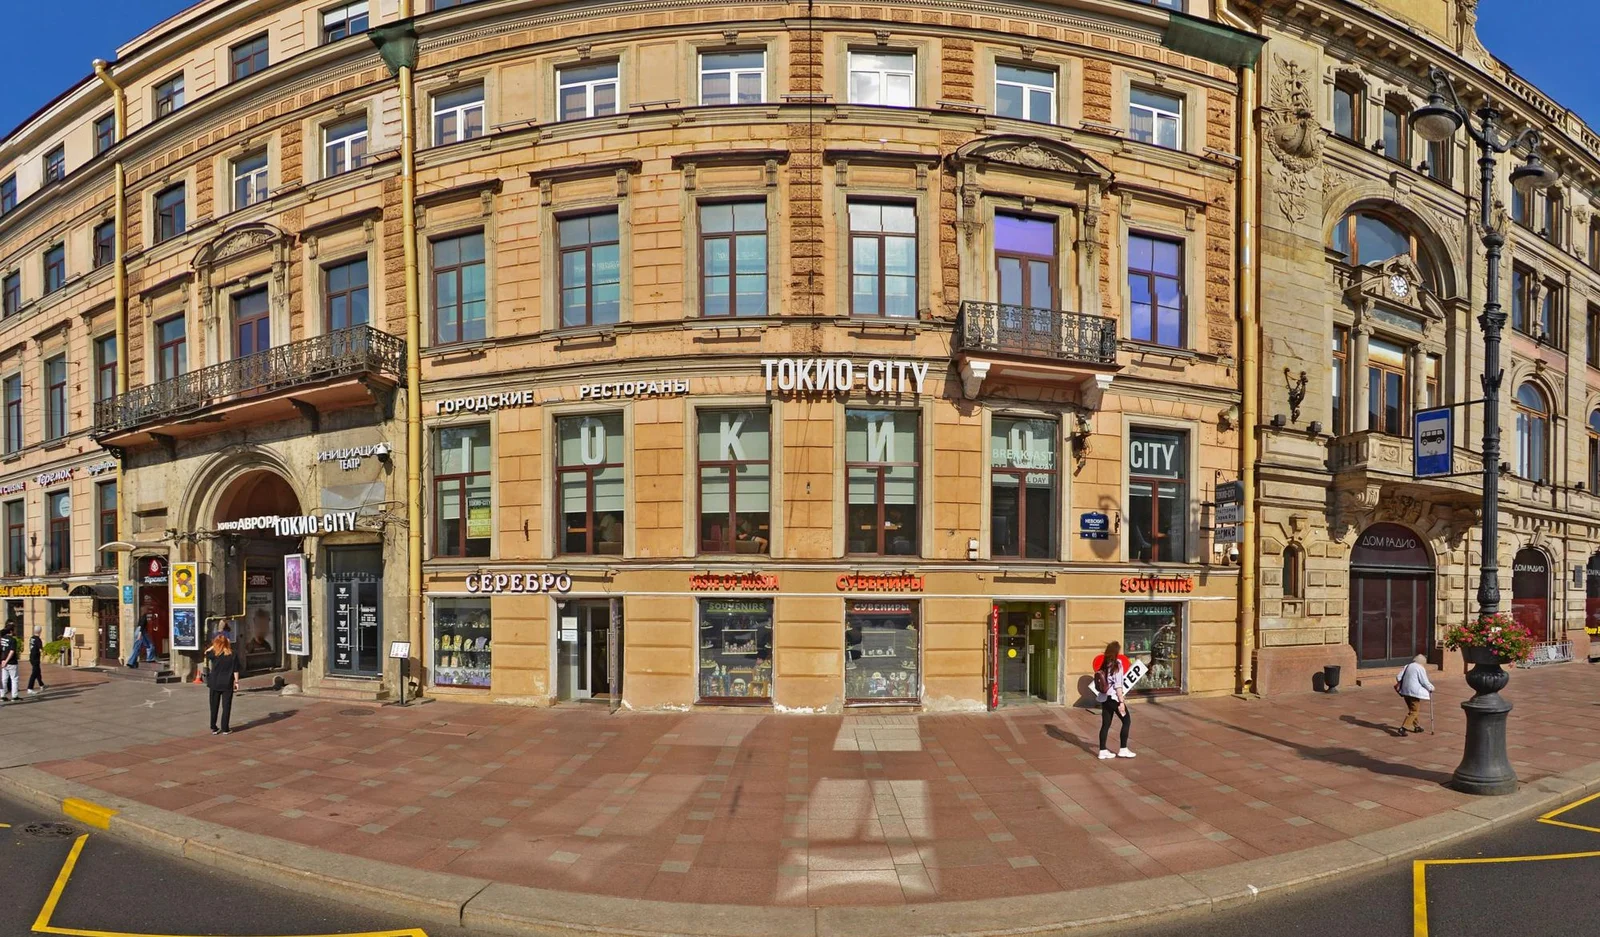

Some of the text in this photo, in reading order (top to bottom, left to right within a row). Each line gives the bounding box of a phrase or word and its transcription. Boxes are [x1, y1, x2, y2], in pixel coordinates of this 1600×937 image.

[761, 359, 929, 394] ТОКИО-CITY
[580, 379, 690, 399] РЕСТОРАНЫ
[436, 391, 534, 413] ГОРОДСКИЕ
[992, 449, 1054, 462] BREAKAST
[1130, 440, 1175, 470] CITY
[340, 458, 360, 469] ТЕАТР
[38, 469, 72, 484] Теремок
[237, 515, 279, 530] АВРОРА
[275, 511, 356, 537] ТОКИО-CITY
[1362, 536, 1416, 549] ДОМ РАДИО
[1514, 564, 1527, 572] ДОМ
[144, 576, 167, 584] Теремок
[465, 573, 572, 592] СЕРЕБРО
[690, 574, 779, 590] TASTE OF RUSSIA
[836, 574, 926, 591] СУВЕНИРЫ
[1120, 577, 1194, 592] SOUVENIRS
[854, 603, 909, 611] СУВЕНИРЫ
